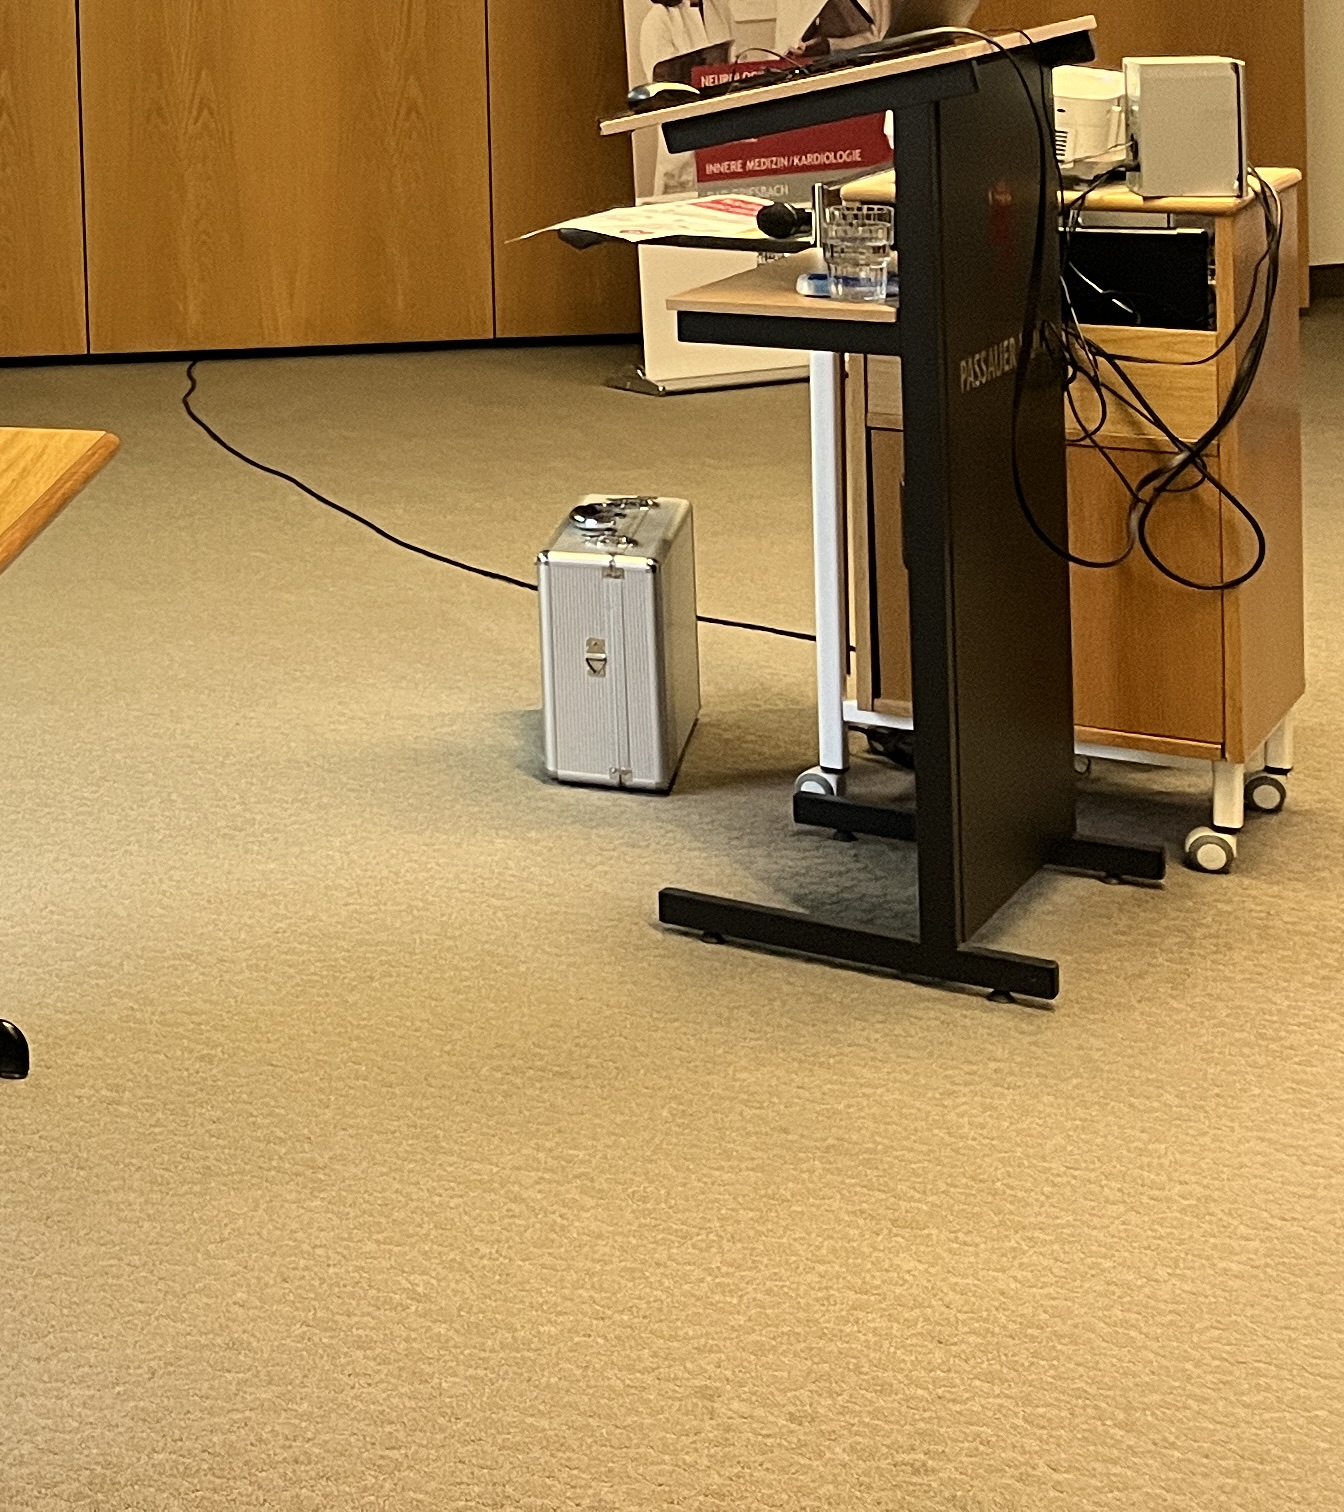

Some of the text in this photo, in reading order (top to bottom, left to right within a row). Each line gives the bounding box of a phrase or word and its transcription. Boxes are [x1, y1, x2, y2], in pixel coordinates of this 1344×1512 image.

[705, 148, 862, 175] INNERE MEDIZIN/KARDIOLOGIE
[960, 337, 1018, 393] PASSAUER
